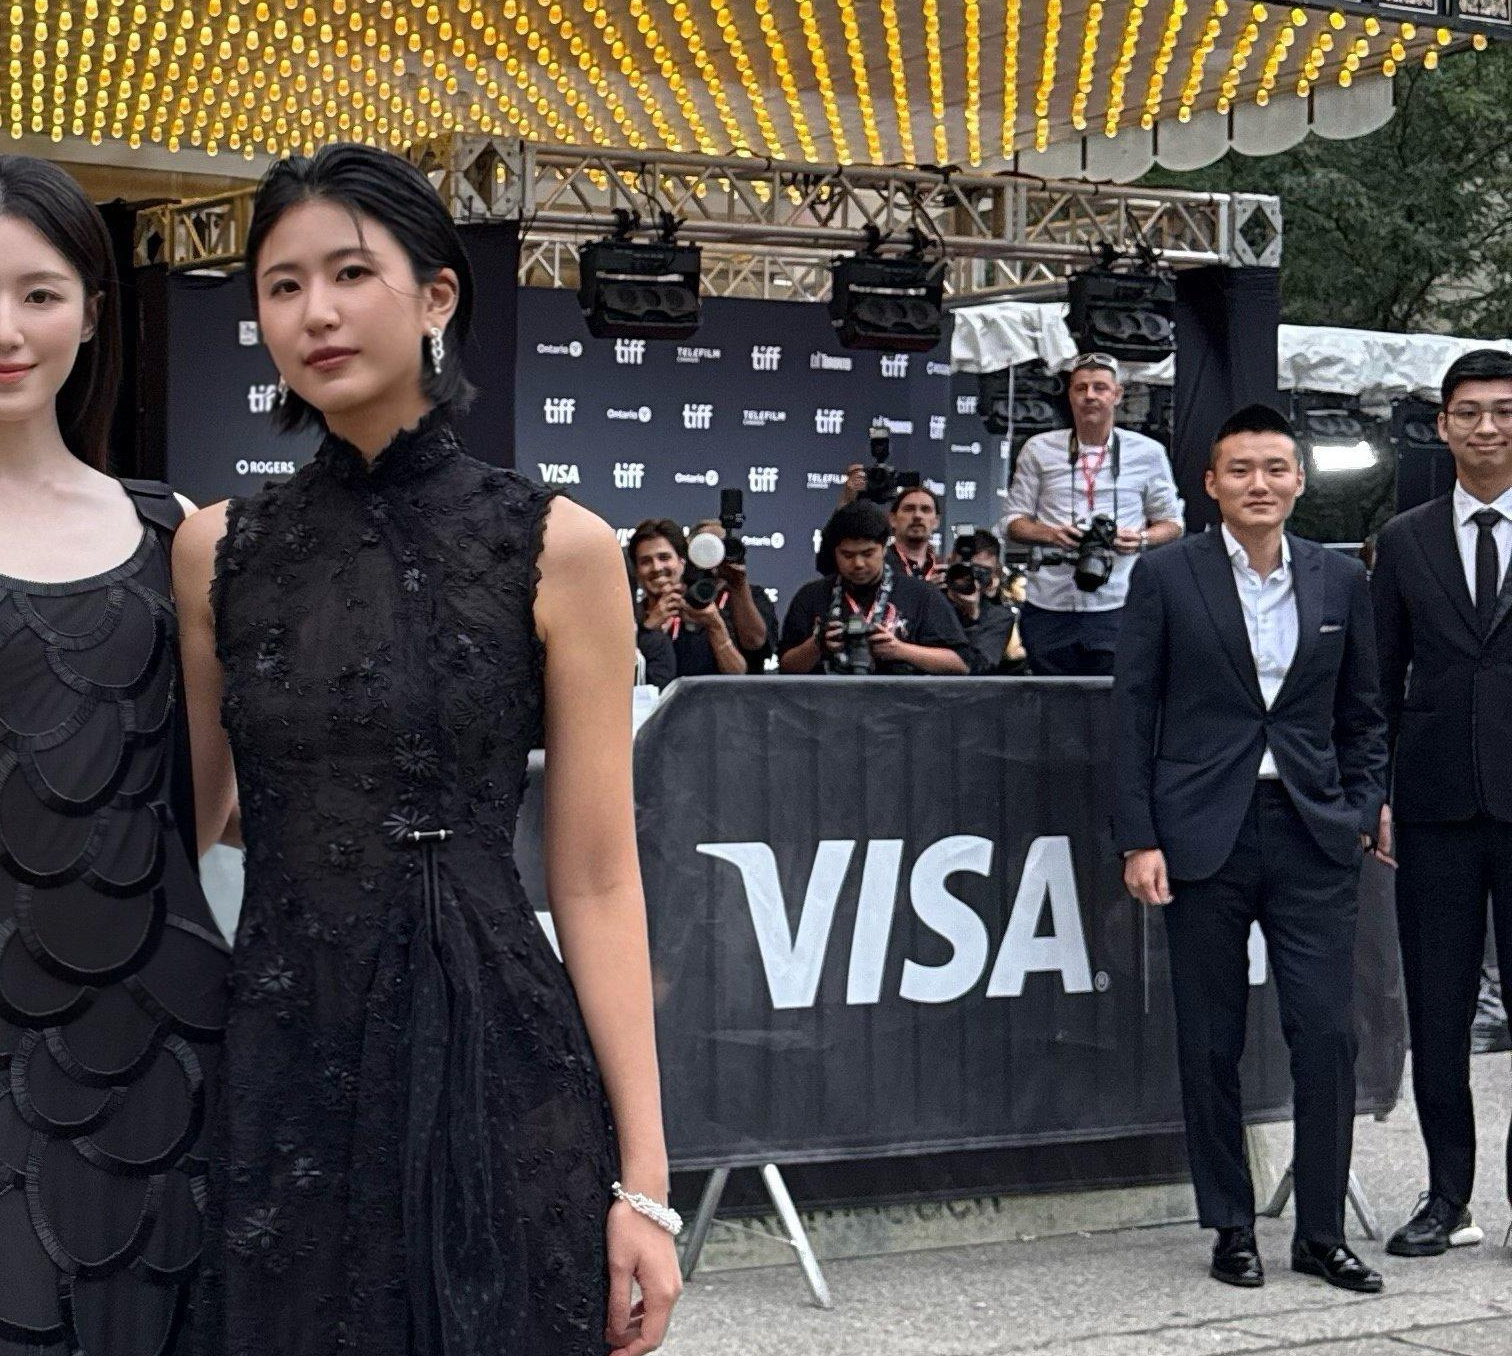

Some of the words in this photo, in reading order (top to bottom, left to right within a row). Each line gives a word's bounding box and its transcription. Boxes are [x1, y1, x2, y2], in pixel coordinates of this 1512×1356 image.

[614, 338, 646, 364] tiff
[751, 345, 781, 370] tiff
[879, 353, 909, 378] tiff
[248, 385, 277, 413] tif
[544, 397, 576, 424] tiff
[682, 403, 713, 429] tiff
[815, 408, 845, 434] tiff
[249, 461, 296, 474] ROGERS
[538, 462, 581, 485] VISA
[613, 462, 645, 489] tiff
[748, 466, 779, 492] tiff
[696, 834, 1094, 1011] VISA
